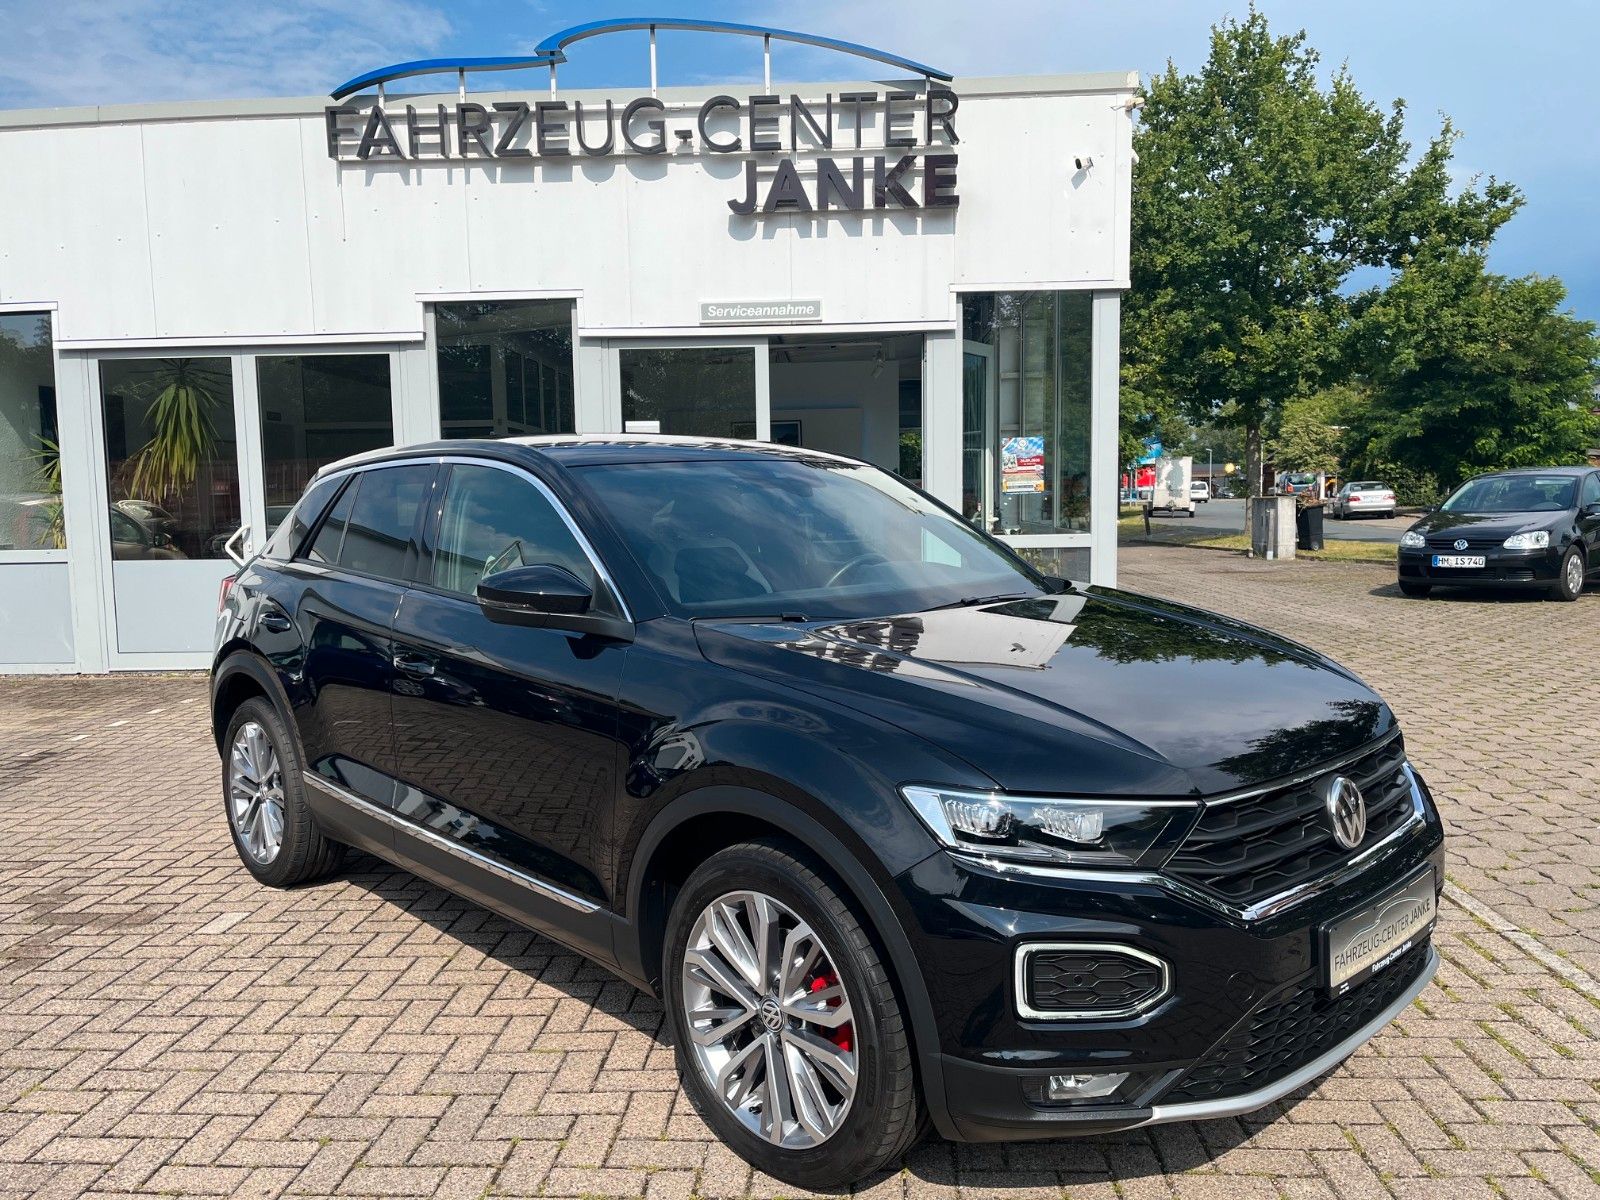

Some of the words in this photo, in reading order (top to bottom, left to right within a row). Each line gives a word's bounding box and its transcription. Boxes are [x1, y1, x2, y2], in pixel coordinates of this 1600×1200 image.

[325, 90, 960, 160] FAHRZEUG-CENTER
[727, 154, 960, 216] JANKE
[707, 304, 815, 317] Serviceannahme
[1334, 917, 1410, 971] FAHRZEUG-CENTER
[1410, 898, 1431, 924] JANKE
